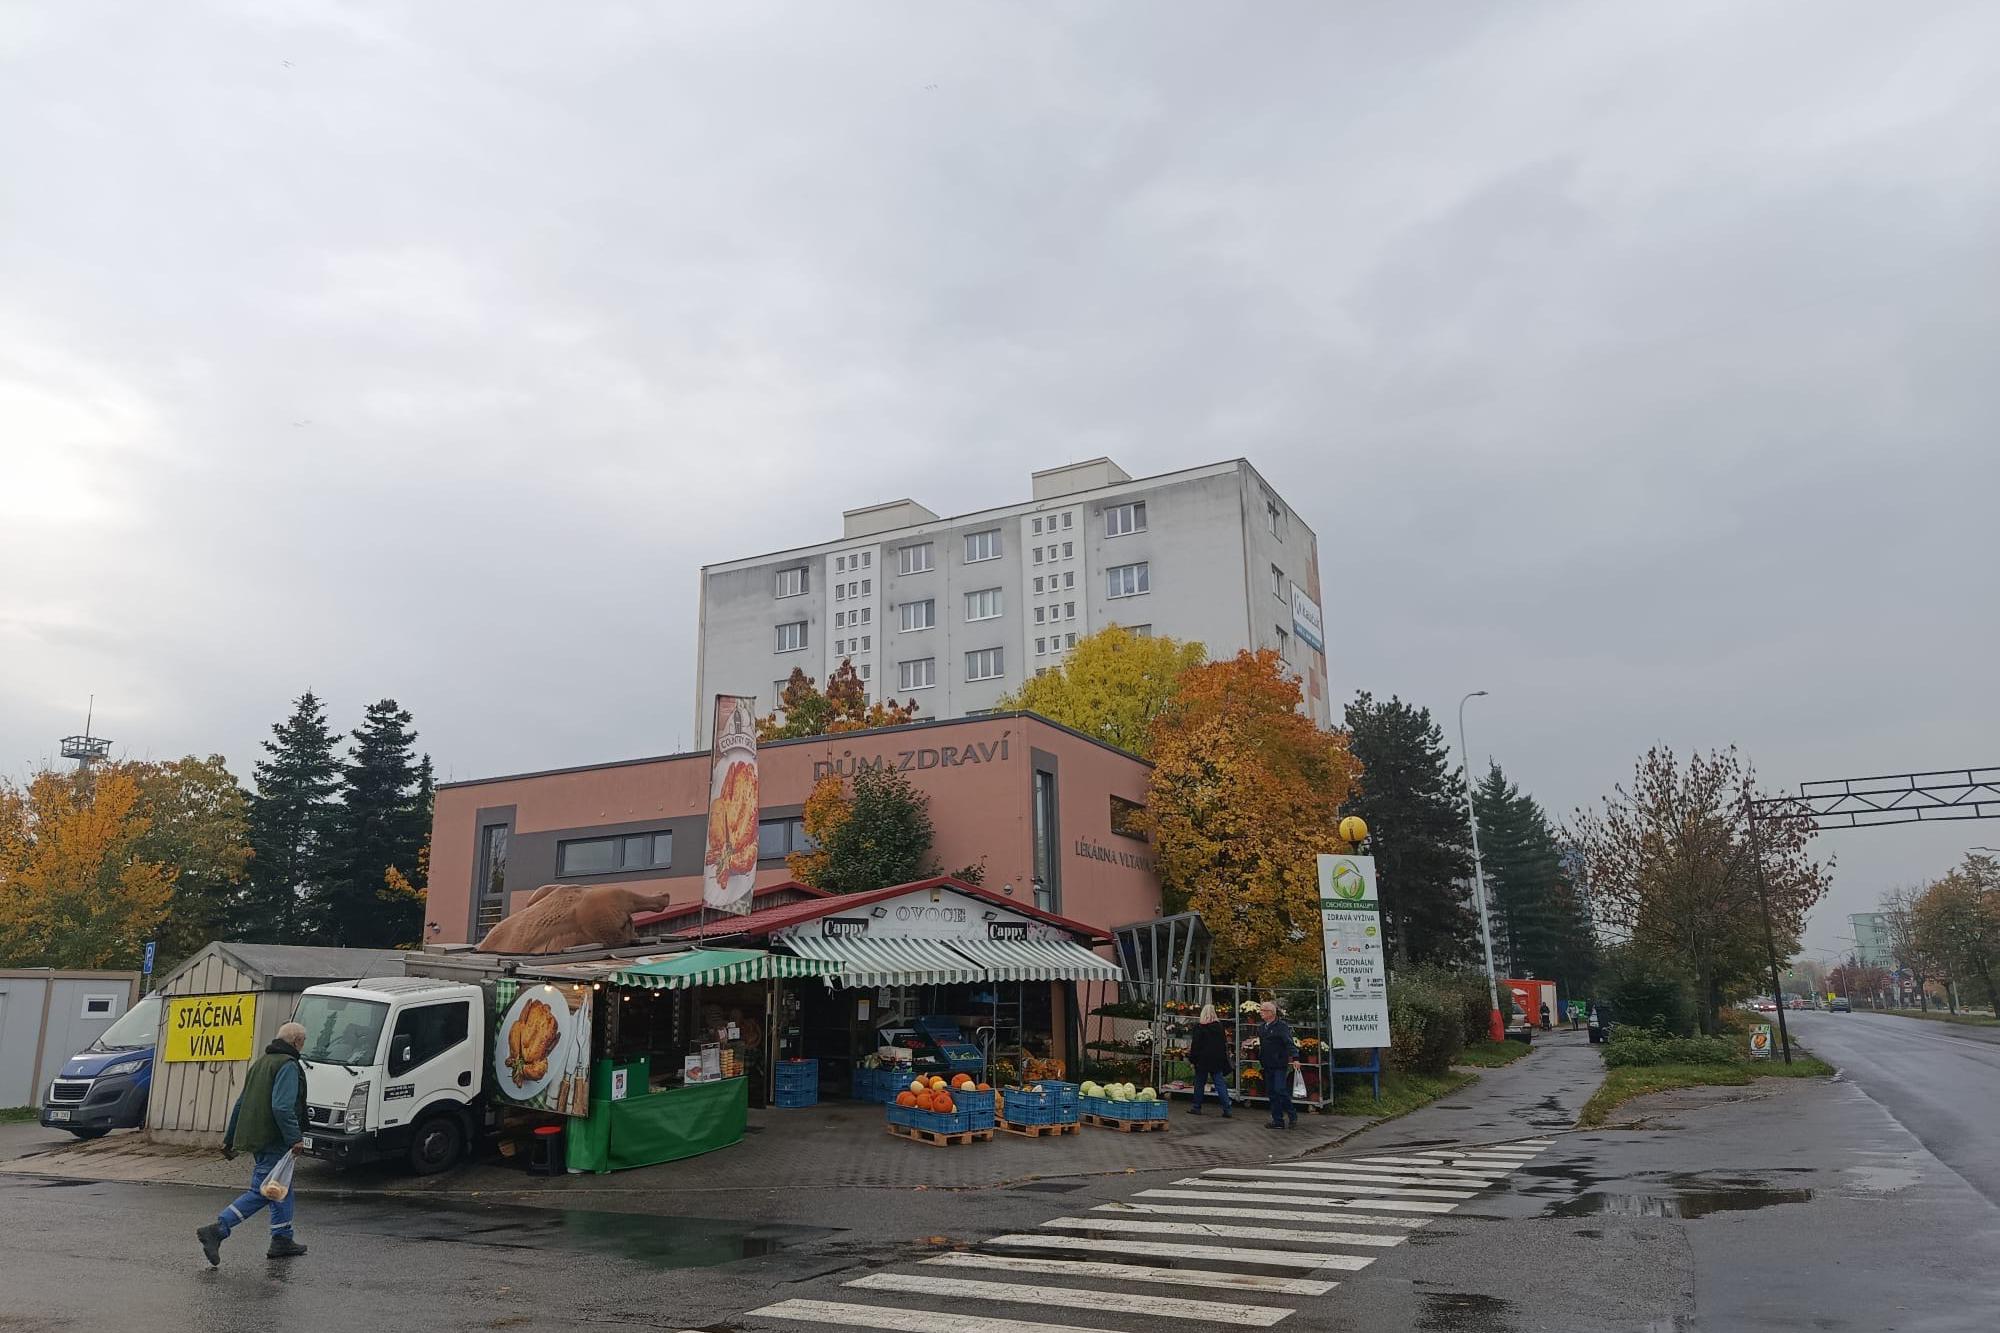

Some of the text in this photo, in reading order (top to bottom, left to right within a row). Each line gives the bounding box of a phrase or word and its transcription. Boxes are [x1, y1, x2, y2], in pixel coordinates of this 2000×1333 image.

[897, 730, 1011, 772] ZDRAVÍ
[1075, 835, 1117, 864] LÉKÁRNA
[895, 906, 966, 923] OVOCE
[824, 920, 866, 938] Cappy
[989, 924, 1026, 941] Cappy
[1338, 966, 1374, 974] POTRAVINY
[178, 998, 243, 1029] STÁČENÁ
[1343, 1023, 1378, 1032] POTRAVINY
[190, 1029, 225, 1057] VÍNA
